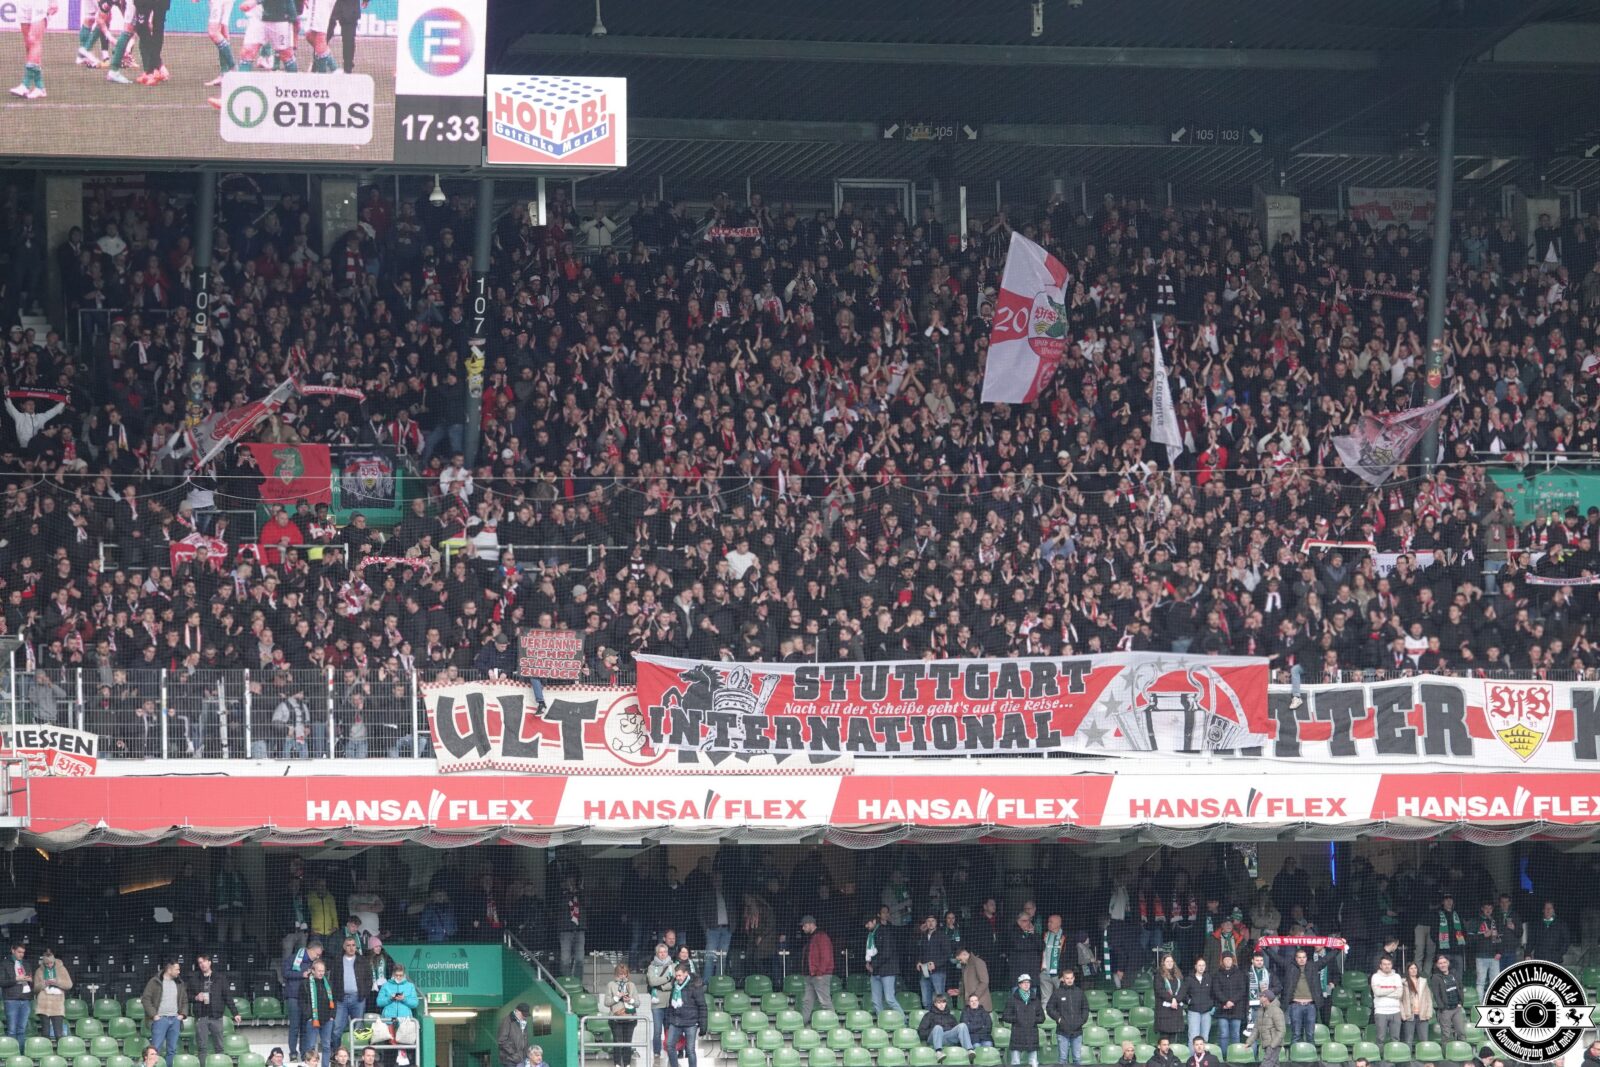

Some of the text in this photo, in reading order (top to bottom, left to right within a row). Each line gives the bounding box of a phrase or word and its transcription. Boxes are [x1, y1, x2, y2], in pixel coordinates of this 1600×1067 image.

[275, 86, 330, 99] bremen
[273, 100, 370, 129] eins
[401, 114, 480, 141] 17:33
[935, 126, 953, 137] 105
[1196, 129, 1214, 140] 105
[1222, 129, 1239, 140] 103
[563, 124, 607, 153] Markt
[474, 276, 486, 335] 107
[520, 636, 582, 651] VERBANNTE
[526, 648, 577, 659] KEHRT
[794, 660, 1093, 702] STUTTGART
[783, 702, 816, 715] Nach
[820, 702, 841, 715] all
[842, 702, 867, 715] der
[869, 702, 924, 715] Scheiße
[926, 701, 970, 716] geht's
[972, 700, 998, 714] auf
[1000, 700, 1021, 713] die
[648, 706, 1062, 752] INTERNATIONAL
[306, 799, 534, 821] HANSA FLEX
[583, 799, 807, 820] HANSA FLEX
[857, 798, 1079, 820] HANSA FLEX
[1129, 797, 1348, 818] HANSA FLEX
[1397, 796, 1511, 817] HANSA
[426, 961, 469, 970] wohninvest
